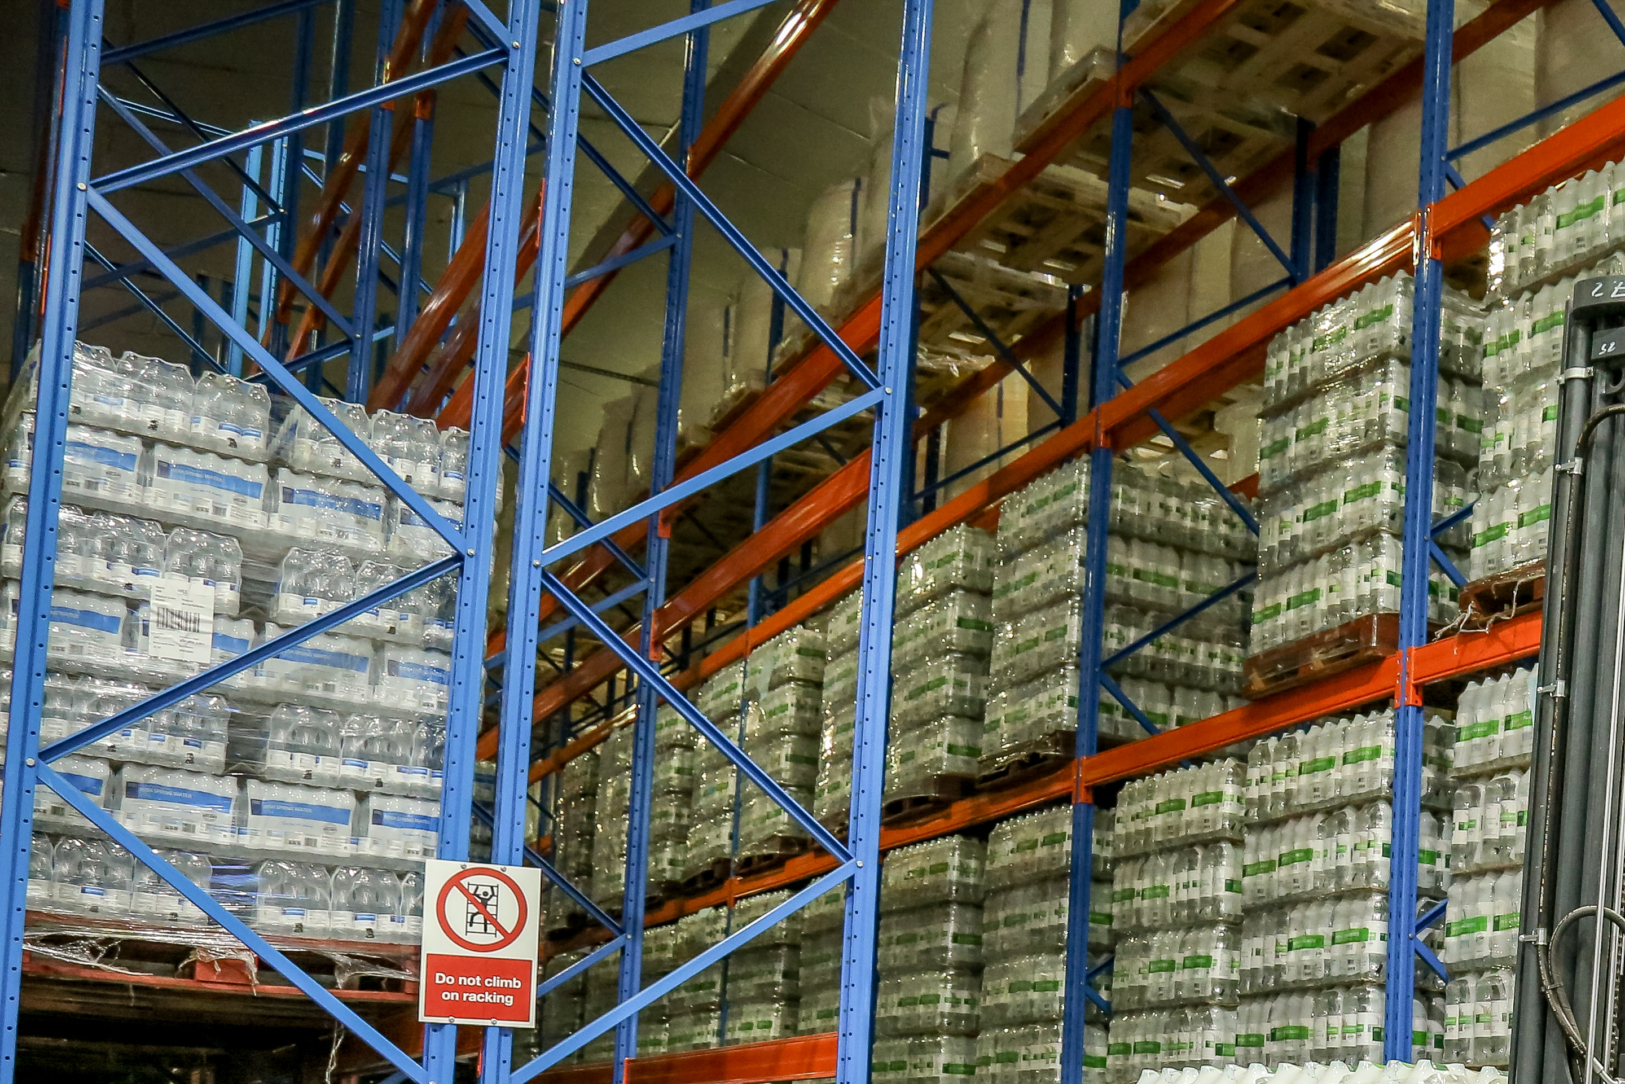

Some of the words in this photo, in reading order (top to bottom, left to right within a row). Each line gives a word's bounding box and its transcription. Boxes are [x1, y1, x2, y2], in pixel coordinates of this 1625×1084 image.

[435, 972, 455, 985] Do
[458, 975, 482, 987] not
[484, 977, 522, 989] climb
[442, 990, 460, 1001] on
[462, 992, 514, 1006] racking
